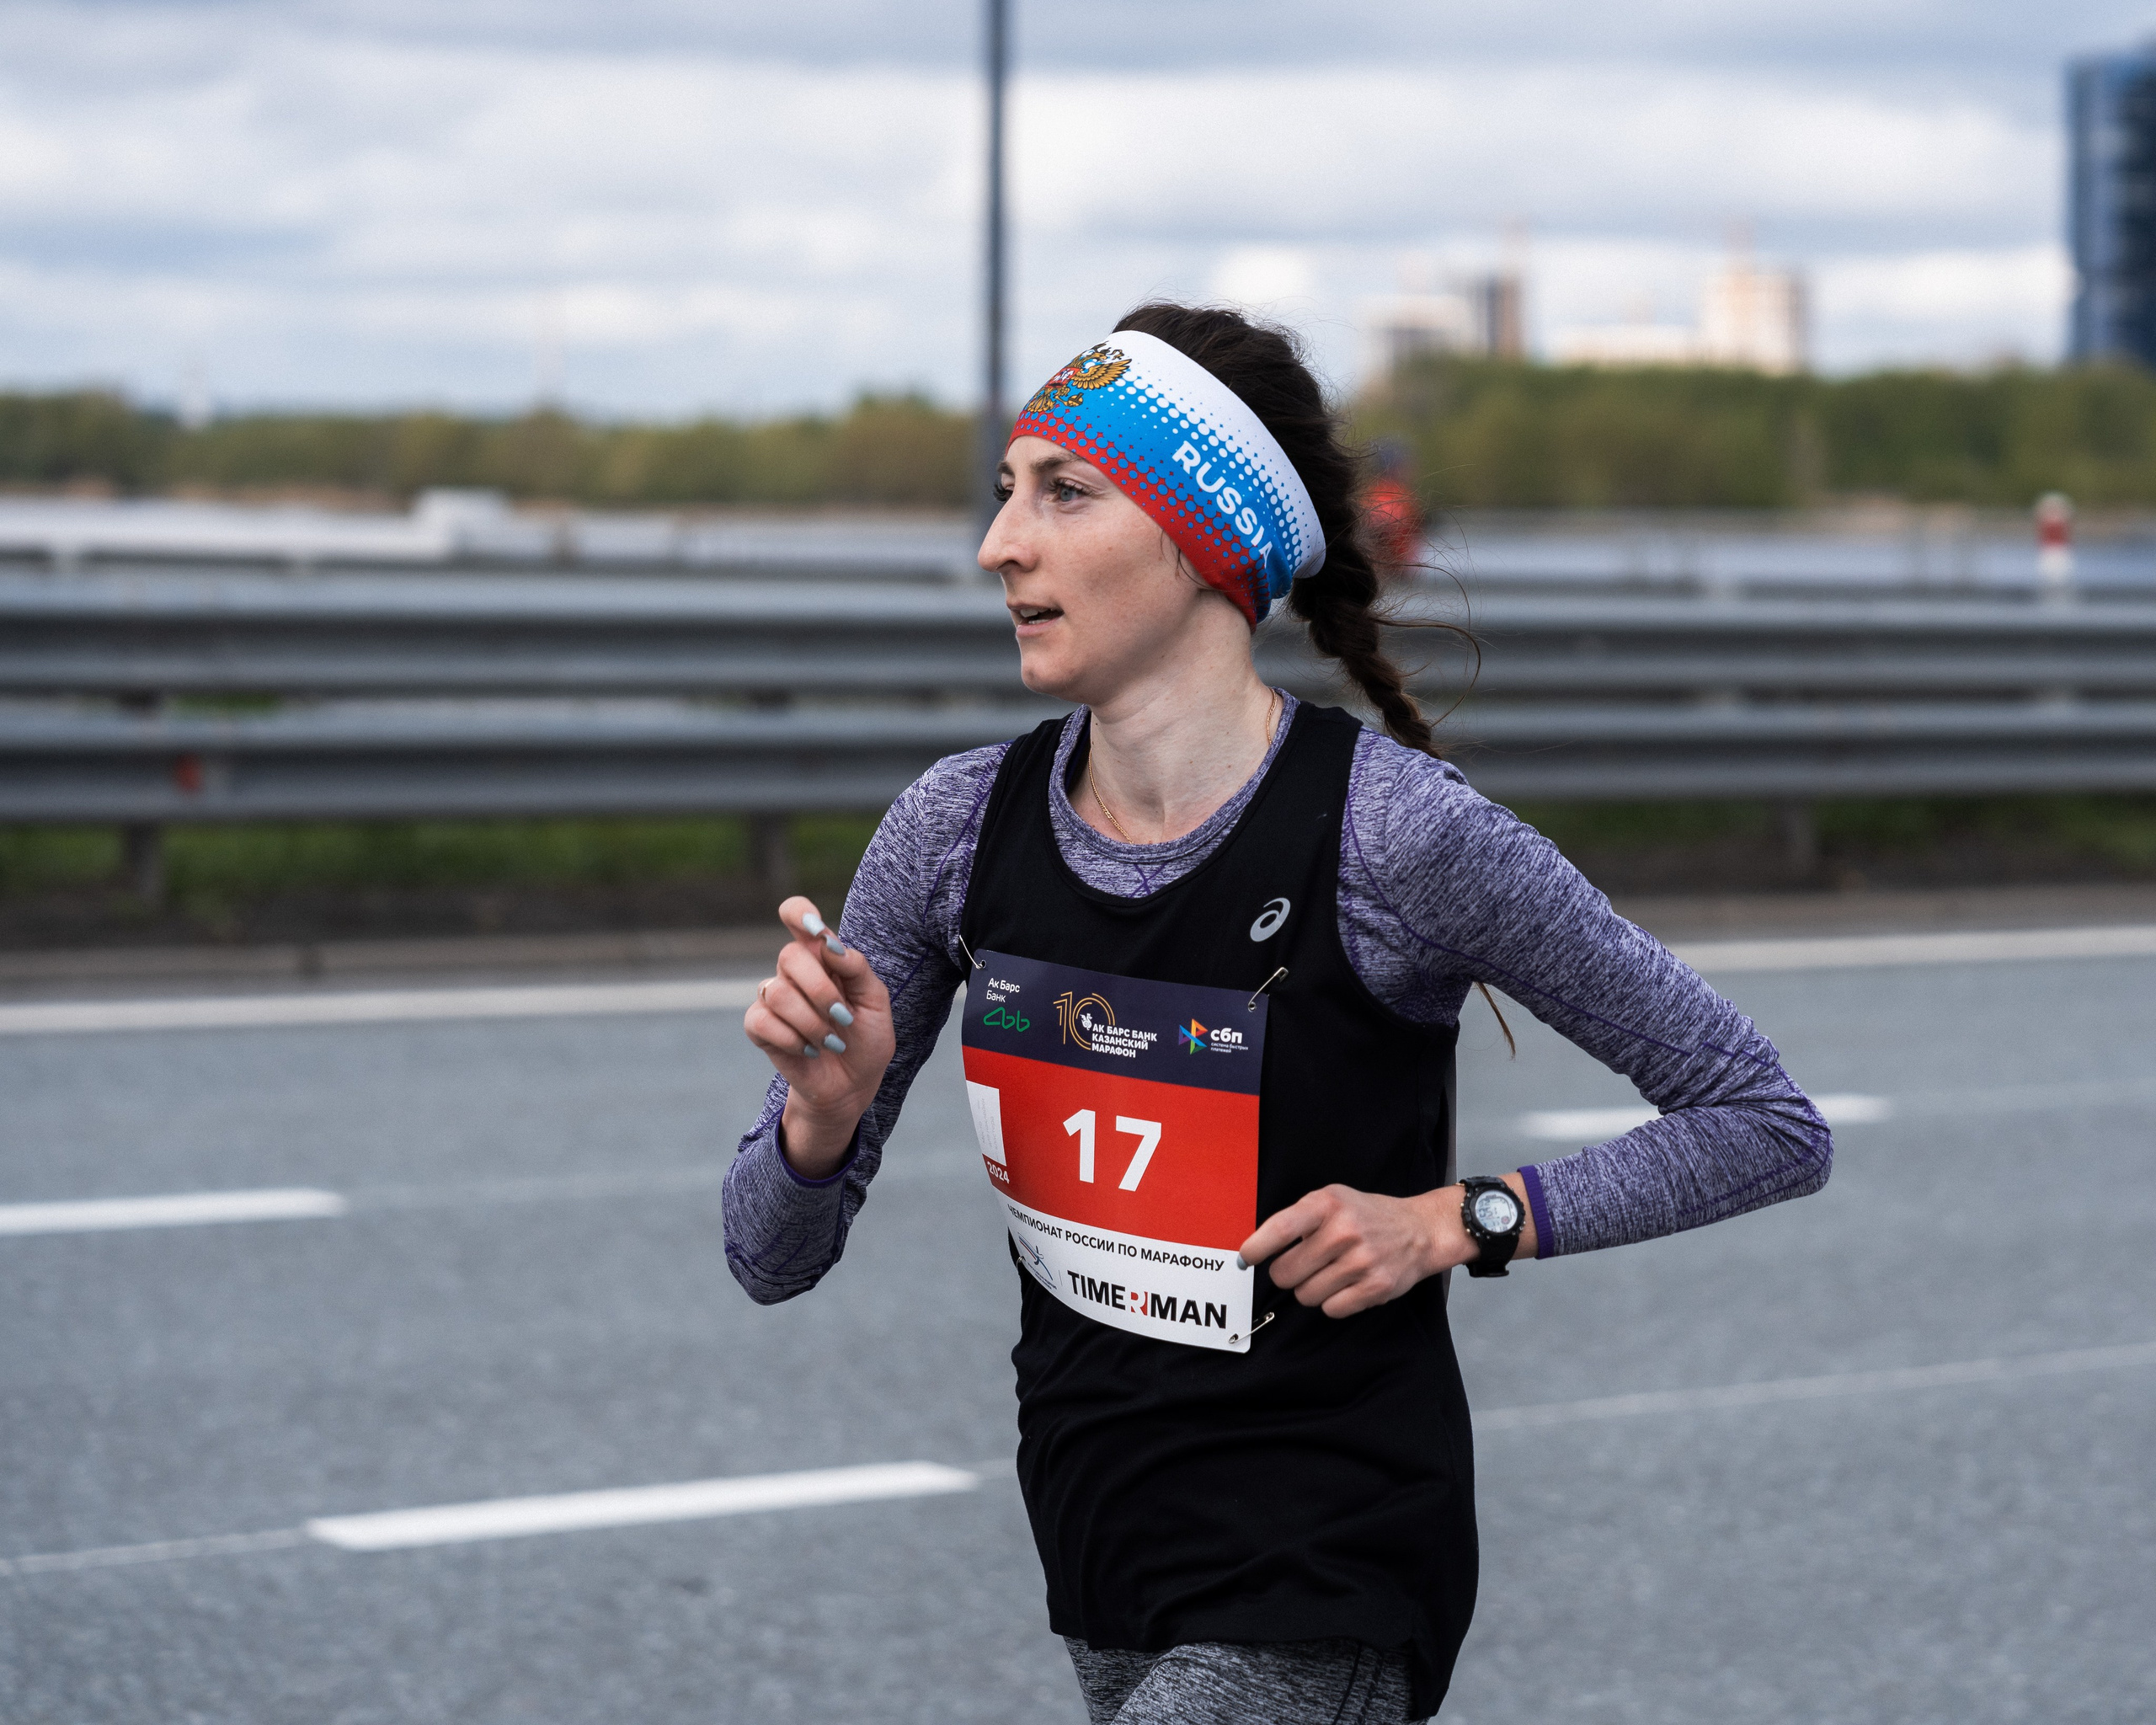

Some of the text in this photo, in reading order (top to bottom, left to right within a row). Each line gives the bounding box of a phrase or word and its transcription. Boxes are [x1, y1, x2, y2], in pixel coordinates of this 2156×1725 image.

[1171, 440, 1273, 569] RUSSIA
[988, 977, 1021, 994] Ак Барс
[986, 990, 1006, 1003] Банк
[1091, 1033, 1149, 1050] КАЗАНСКИЙ
[1092, 1023, 1157, 1042] АК БАРС БАНК
[1210, 1028, 1243, 1044] сбп
[1091, 1043, 1136, 1059] МАРАФОН
[1063, 1108, 1162, 1193] 17
[987, 1161, 1010, 1184] 2024
[1006, 1203, 1225, 1271] ЧЕМПИОНАТ РОССИИ ПО МАРАФОНУ
[1067, 1269, 1228, 1330] TIMERMAN
